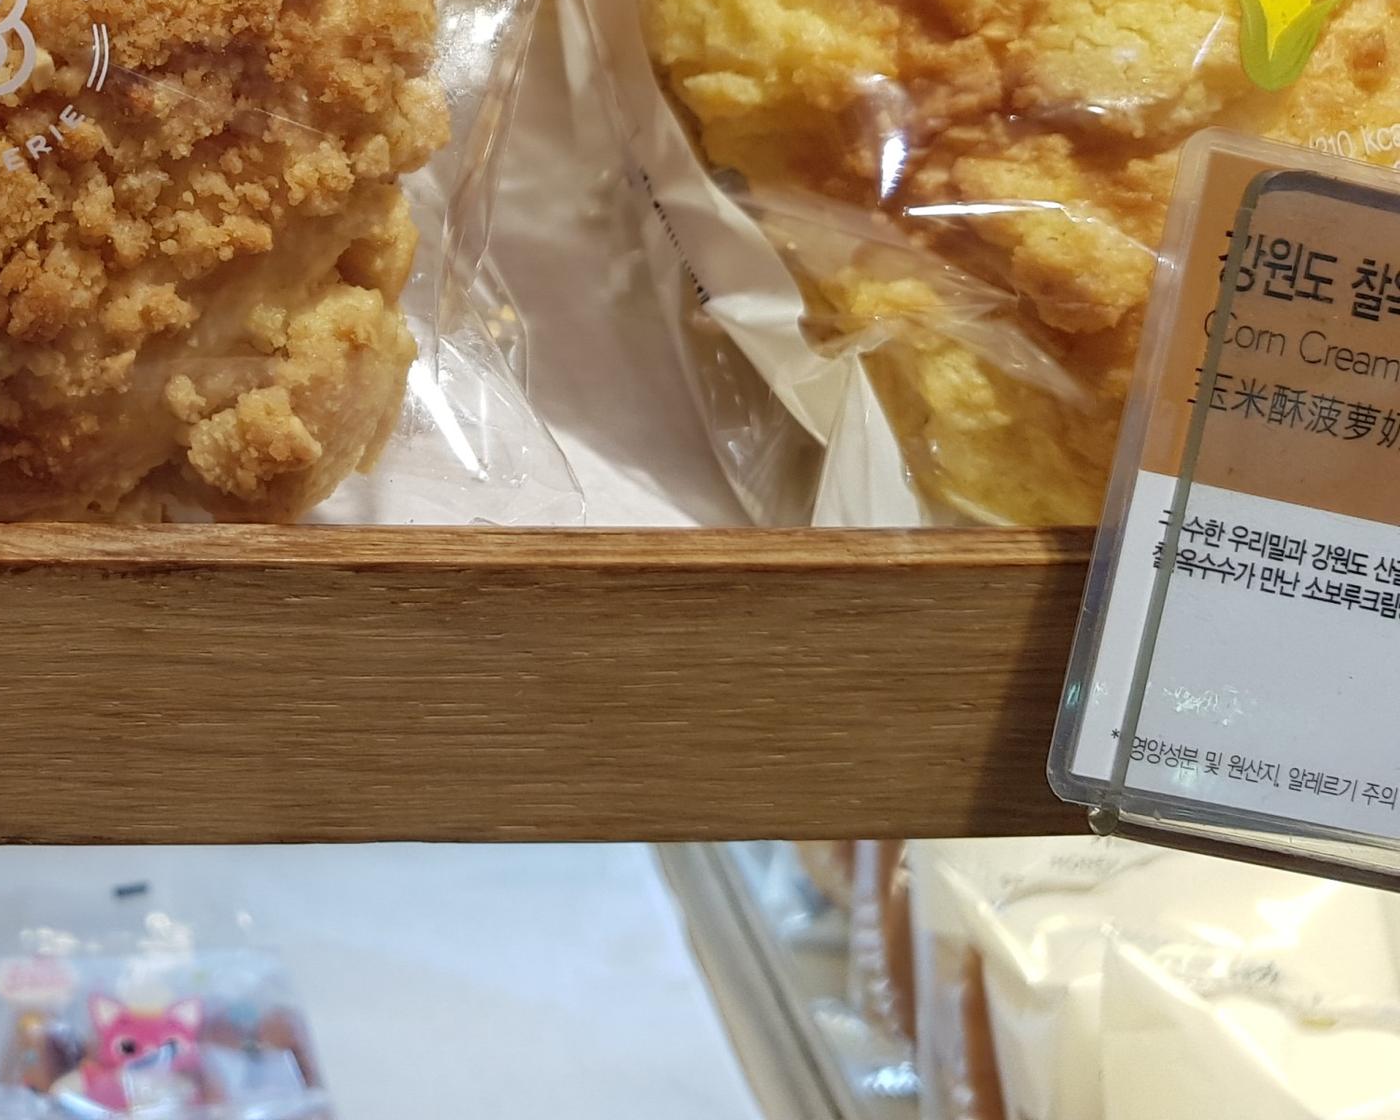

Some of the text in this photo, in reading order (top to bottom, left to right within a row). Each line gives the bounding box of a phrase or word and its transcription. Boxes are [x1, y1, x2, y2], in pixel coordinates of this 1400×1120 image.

[1351, 258, 1400, 322] 찰
[1204, 309, 1286, 357] Corn
[1228, 525, 1308, 567] 우리밀과
[1311, 543, 1370, 577] 강원도
[1260, 567, 1301, 598] 만난
[1301, 576, 1400, 621] 소보루크림
[1204, 751, 1223, 776] 및
[1288, 766, 1359, 803] 알레르기
